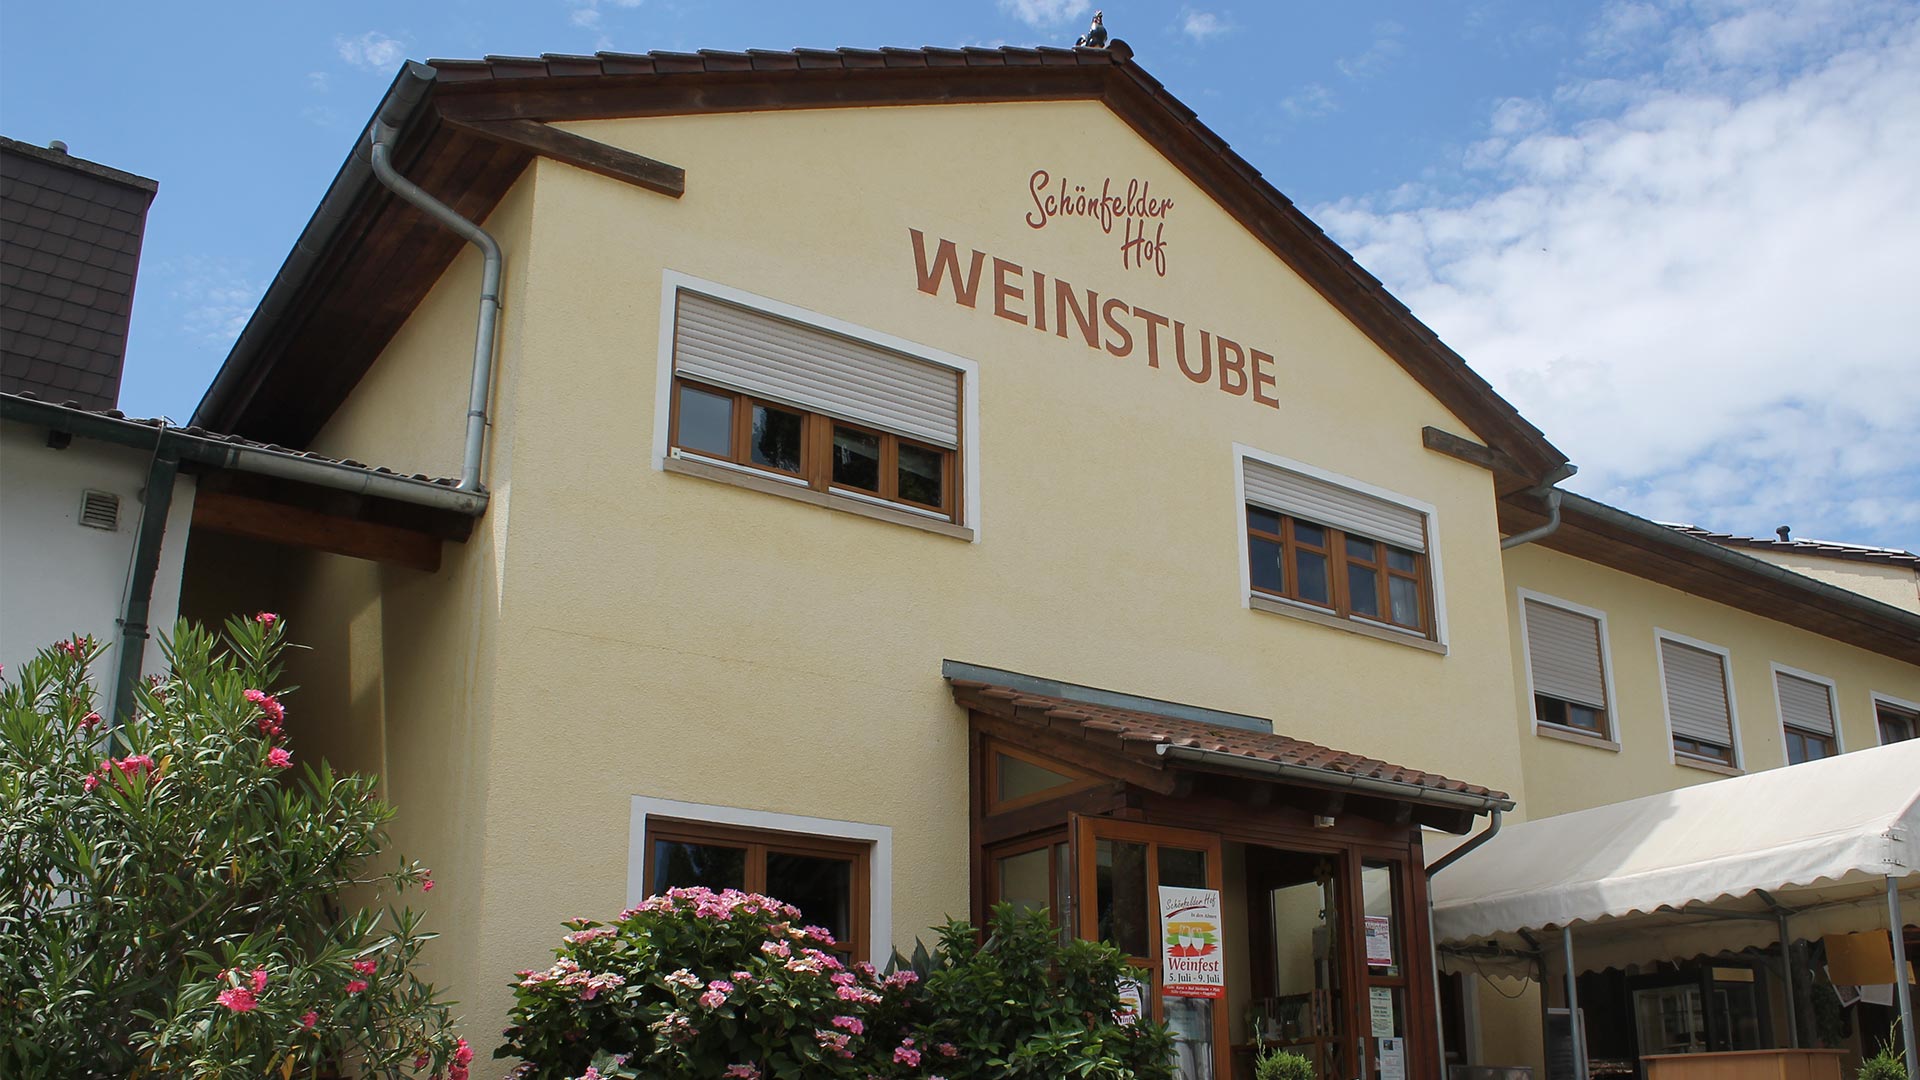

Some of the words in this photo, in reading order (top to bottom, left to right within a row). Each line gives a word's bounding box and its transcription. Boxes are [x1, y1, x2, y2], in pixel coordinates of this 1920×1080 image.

[1026, 170, 1174, 234] Schönfelder
[1121, 217, 1167, 277] Hof
[909, 228, 1280, 409] WEINSTUBE
[1204, 893, 1217, 907] Hof
[1168, 957, 1219, 973] Weinfest
[1169, 972, 1176, 982] 5.
[1178, 973, 1191, 983] Juli
[1198, 974, 1205, 983] 9.
[1207, 974, 1220, 984] Juli
